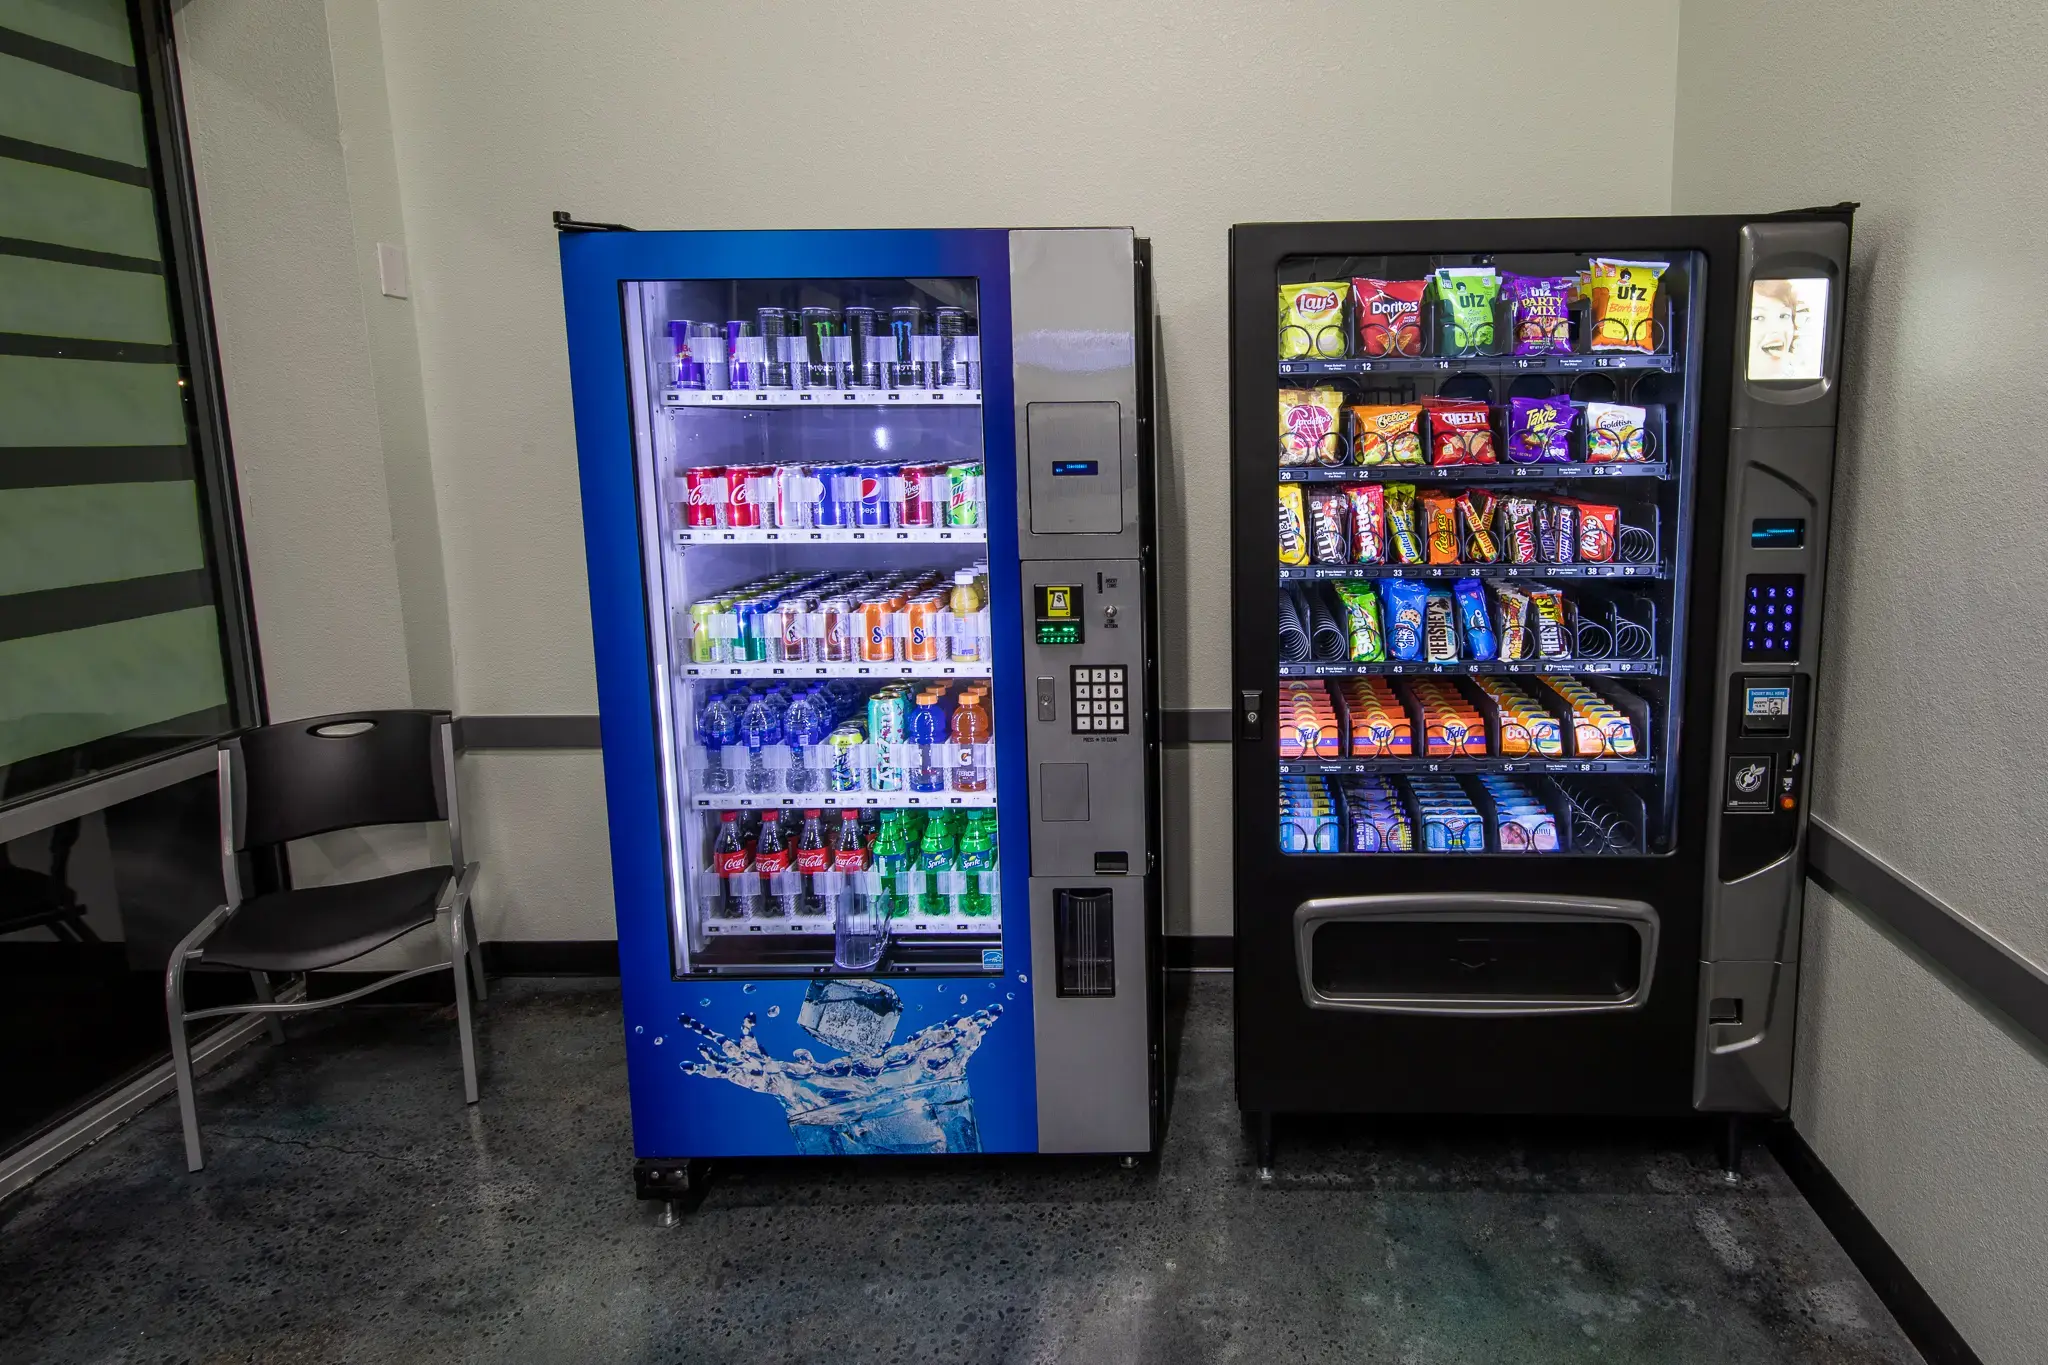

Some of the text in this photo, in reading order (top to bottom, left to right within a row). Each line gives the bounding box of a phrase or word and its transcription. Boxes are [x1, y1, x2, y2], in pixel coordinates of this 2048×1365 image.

[1299, 292, 1335, 312] Lay's
[1522, 296, 1564, 308] PARTY
[1372, 300, 1418, 315] Doritos
[1530, 306, 1556, 316] MIX
[1362, 362, 1372, 370] 12
[1439, 361, 1448, 369] 14
[1518, 360, 1528, 368] 16
[1598, 358, 1608, 366] 18
[1281, 364, 1291, 372] 10
[1376, 412, 1409, 428] Cheetos
[1527, 407, 1557, 427] Takis
[1600, 420, 1632, 429] Goldfish
[1282, 472, 1291, 480] 20
[1359, 470, 1368, 478] 22
[1438, 469, 1447, 477] 24
[1516, 468, 1527, 476] 26
[1594, 467, 1604, 475] 28
[1356, 493, 1378, 556] Skittles
[1392, 515, 1415, 558] Butterfinger
[1434, 513, 1449, 554] Reese's
[1514, 515, 1534, 563] TWIX
[1280, 570, 1289, 578] 30
[1547, 568, 1556, 576] 37
[1752, 588, 1757, 598] 1
[1770, 588, 1776, 597] 2
[1786, 588, 1793, 597] 3
[1750, 605, 1756, 615] 4
[1768, 605, 1774, 615] 5
[1785, 605, 1792, 615] 6
[1536, 598, 1560, 652] HERSHEY'S
[1750, 622, 1756, 632] 7
[1767, 622, 1774, 632] 8
[1784, 622, 1791, 632] 9
[1766, 639, 1772, 648] 0
[1316, 666, 1325, 674] 41
[1357, 666, 1367, 674] 42
[1544, 664, 1554, 672] 47
[1584, 664, 1594, 672] 48
[1300, 728, 1318, 742] Tide
[1372, 728, 1392, 741] Tide
[1446, 727, 1466, 741] Tide
[959, 748, 972, 766] G
[928, 857, 947, 869] Sprite
[964, 858, 981, 869] Sprite
